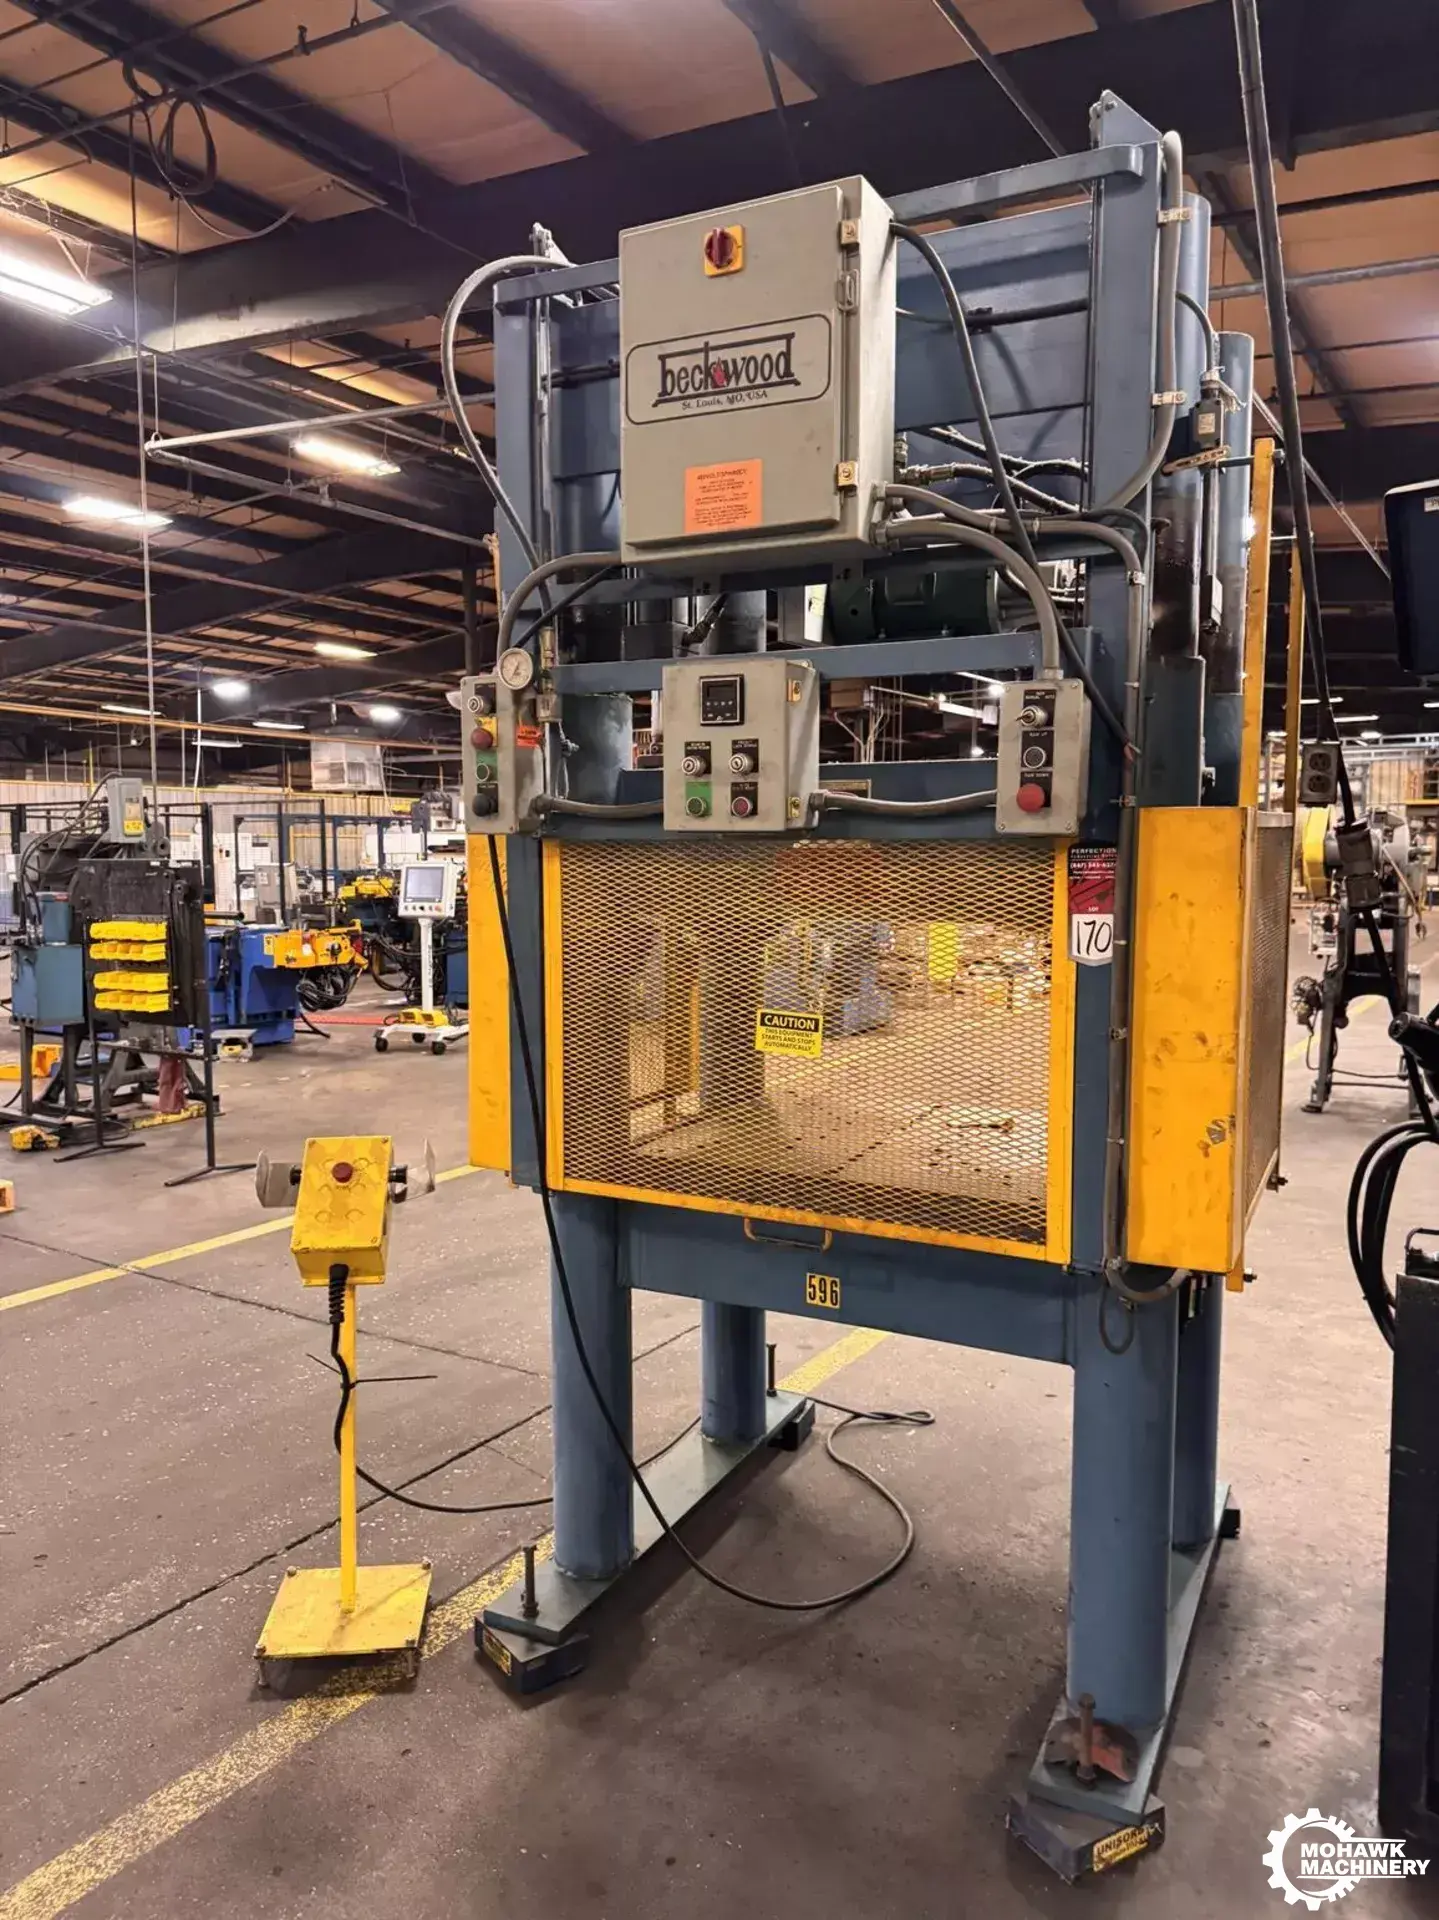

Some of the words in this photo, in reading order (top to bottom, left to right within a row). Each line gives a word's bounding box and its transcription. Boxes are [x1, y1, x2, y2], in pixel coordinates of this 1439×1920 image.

[657, 332, 796, 398] beckwood
[696, 397, 723, 409] Louis,
[748, 389, 768, 401] USA
[1076, 919, 1113, 956] 170
[764, 1014, 815, 1031] CAUTION
[761, 1034, 783, 1042] STARTS
[779, 1029, 813, 1038] EQUIPMENT
[764, 1041, 812, 1051] AUTOMATICALLY
[808, 1274, 838, 1307] 596
